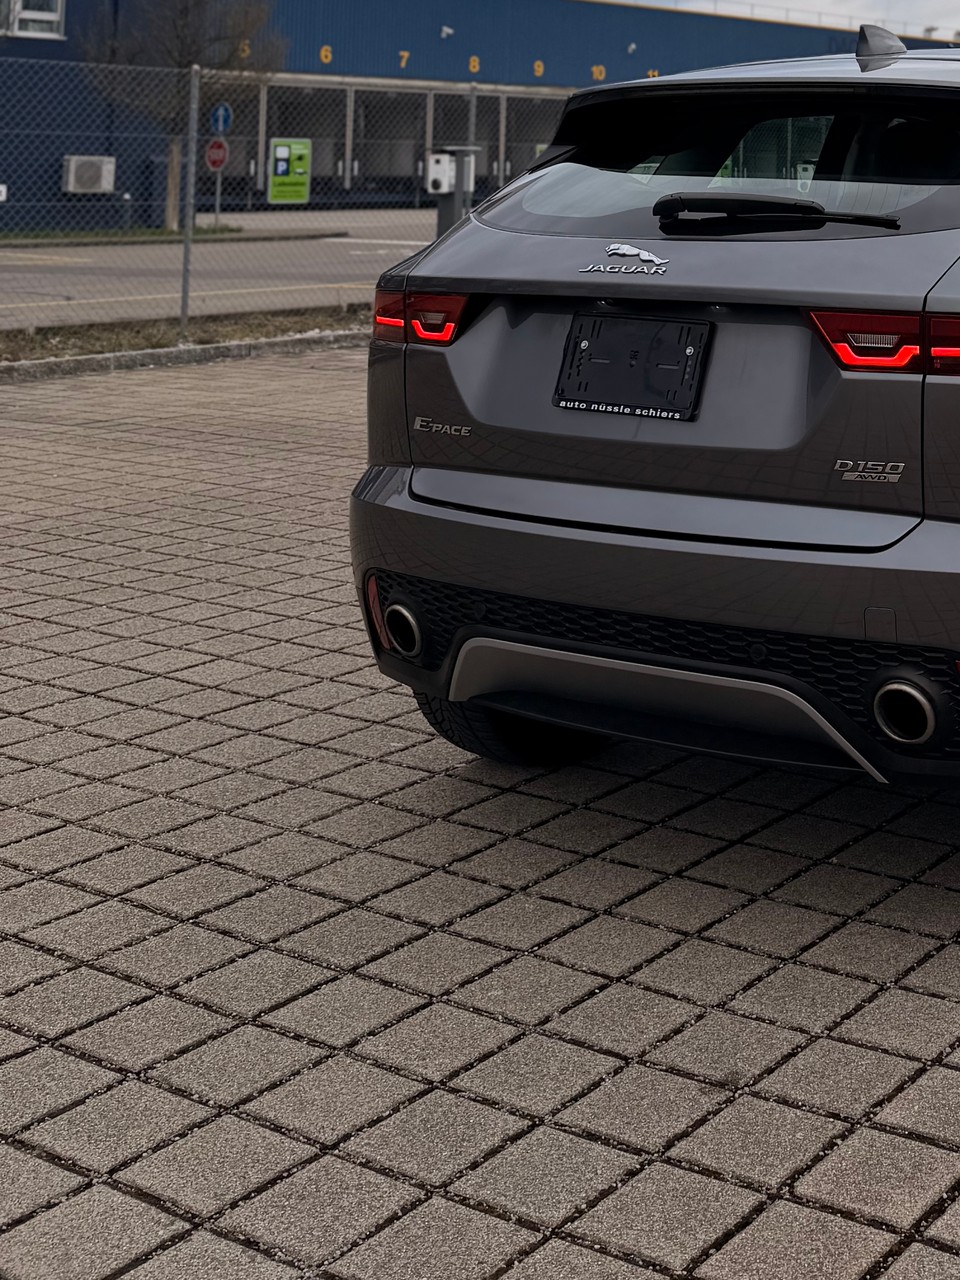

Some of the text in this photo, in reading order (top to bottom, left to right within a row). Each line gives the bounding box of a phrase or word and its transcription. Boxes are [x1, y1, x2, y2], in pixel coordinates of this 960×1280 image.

[320, 45, 332, 64] 6
[399, 51, 410, 68] 7
[469, 55, 480, 73] 8
[533, 60, 544, 77] 9
[591, 65, 606, 81] 10
[277, 161, 287, 174] P
[579, 264, 667, 275] JAGUAR
[559, 400, 681, 419] auto nüssle schiers
[854, 473, 888, 481] AWD
